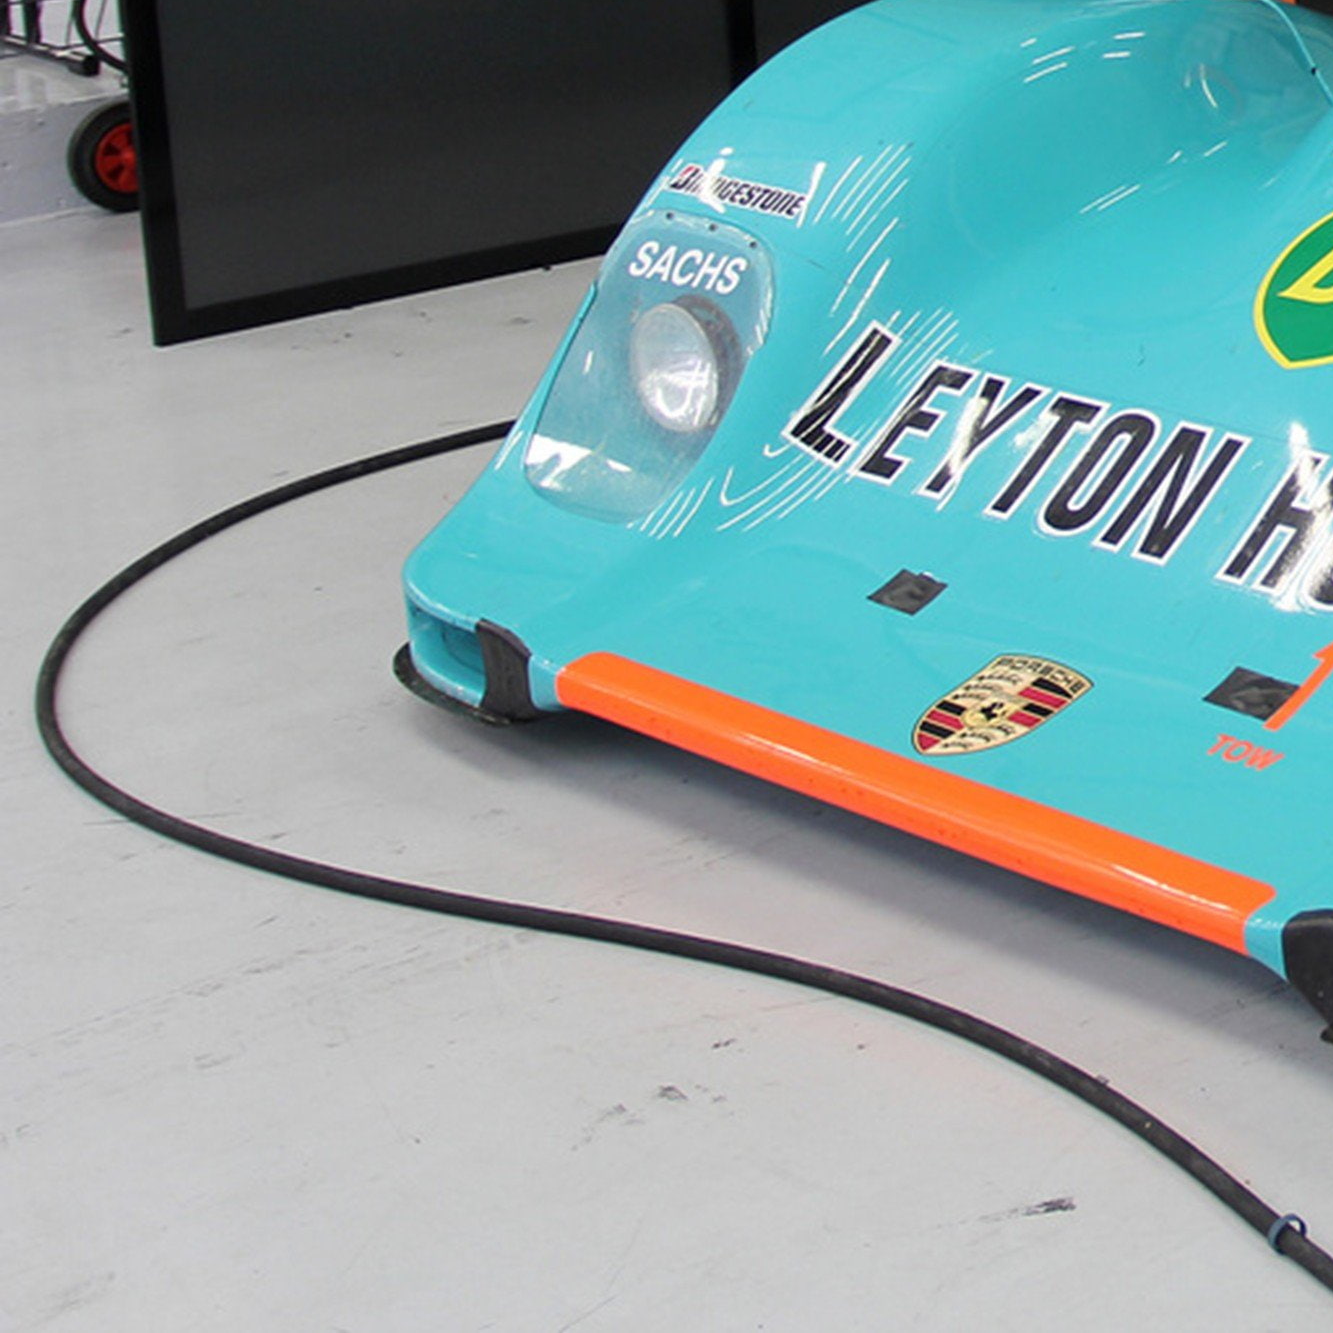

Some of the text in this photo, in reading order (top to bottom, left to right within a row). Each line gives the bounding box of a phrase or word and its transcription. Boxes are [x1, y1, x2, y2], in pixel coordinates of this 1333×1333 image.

[629, 241, 749, 295] SACHS
[784, 321, 1248, 565] LEYTON
[1206, 732, 1285, 771] TOW
